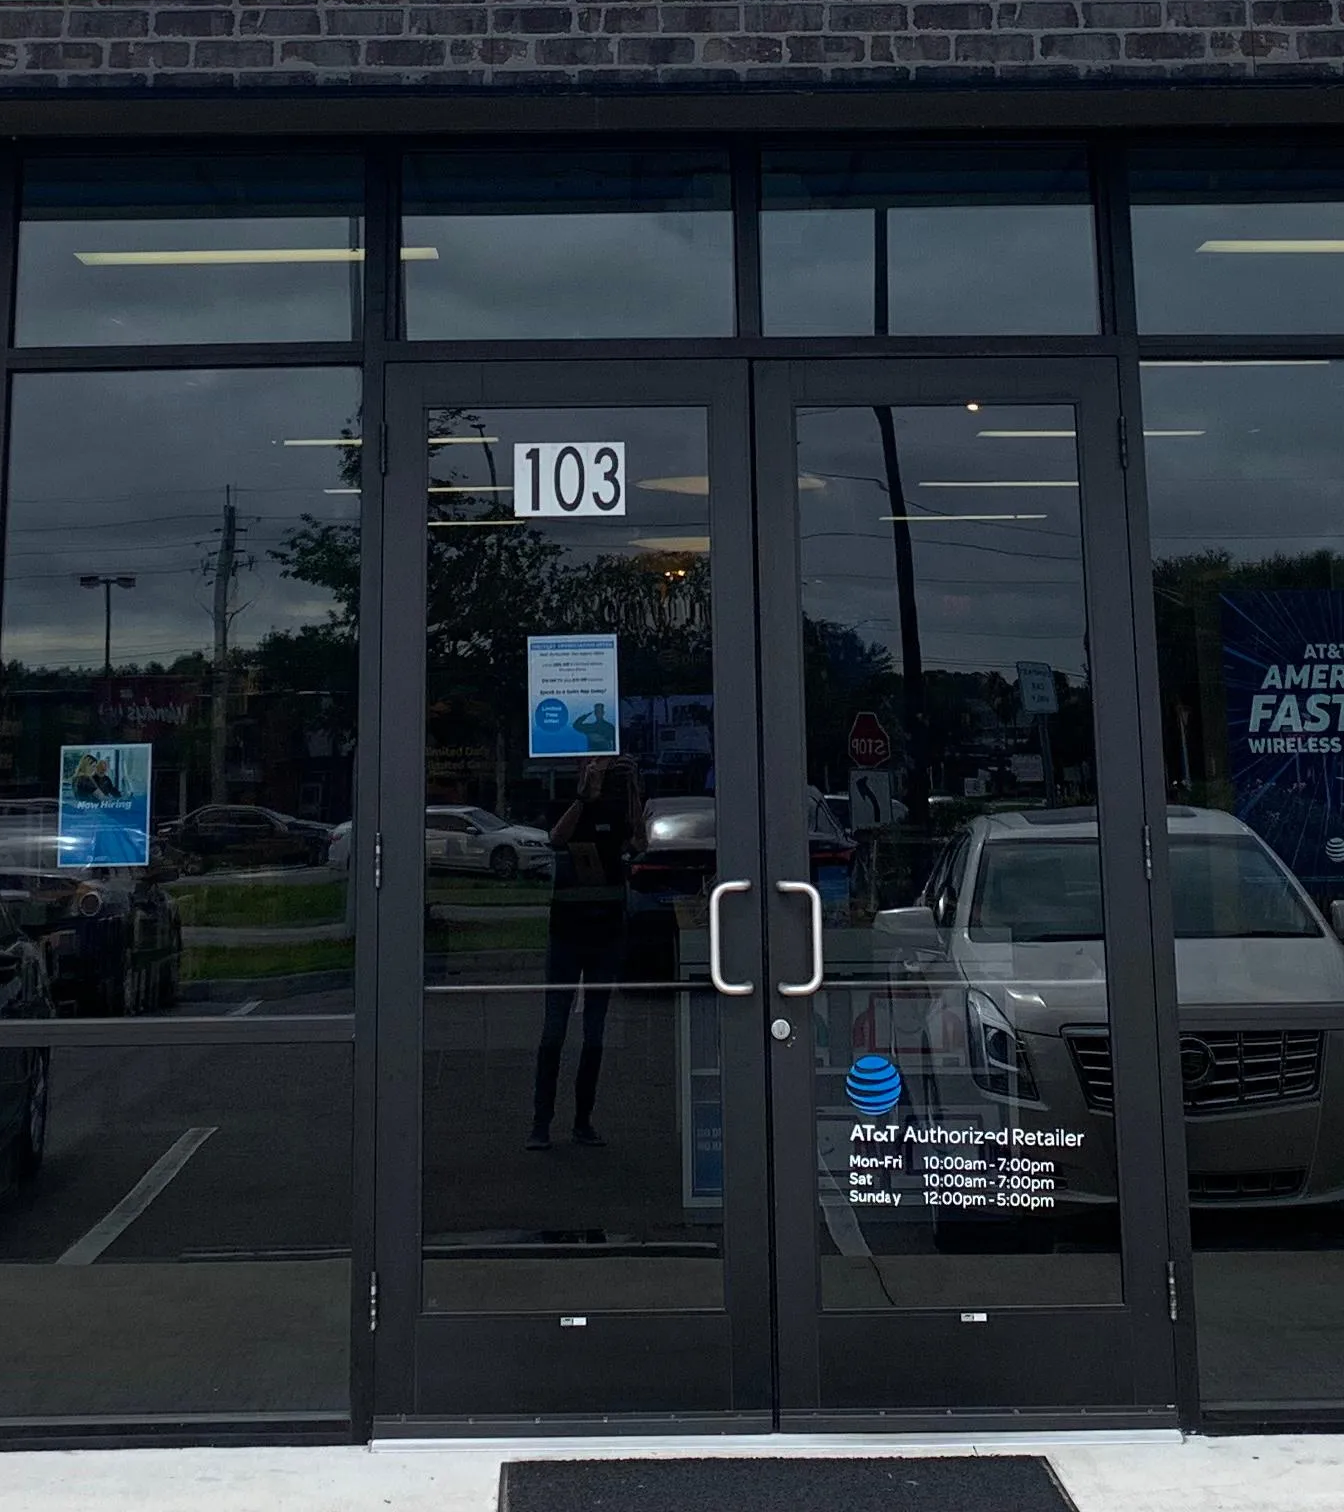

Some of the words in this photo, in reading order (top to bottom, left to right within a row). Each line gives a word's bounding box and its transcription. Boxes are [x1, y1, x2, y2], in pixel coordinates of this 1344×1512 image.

[525, 445, 621, 512] 103
[1248, 737, 1343, 753] WIRELESS
[76, 801, 99, 810] Now
[100, 799, 133, 810] Hiring
[849, 1124, 899, 1142] AT&T
[1013, 1128, 1085, 1147] Retailer
[849, 1155, 903, 1169] Mon-Fri
[849, 1173, 873, 1186] Sat
[849, 1190, 902, 1207] Sunday
